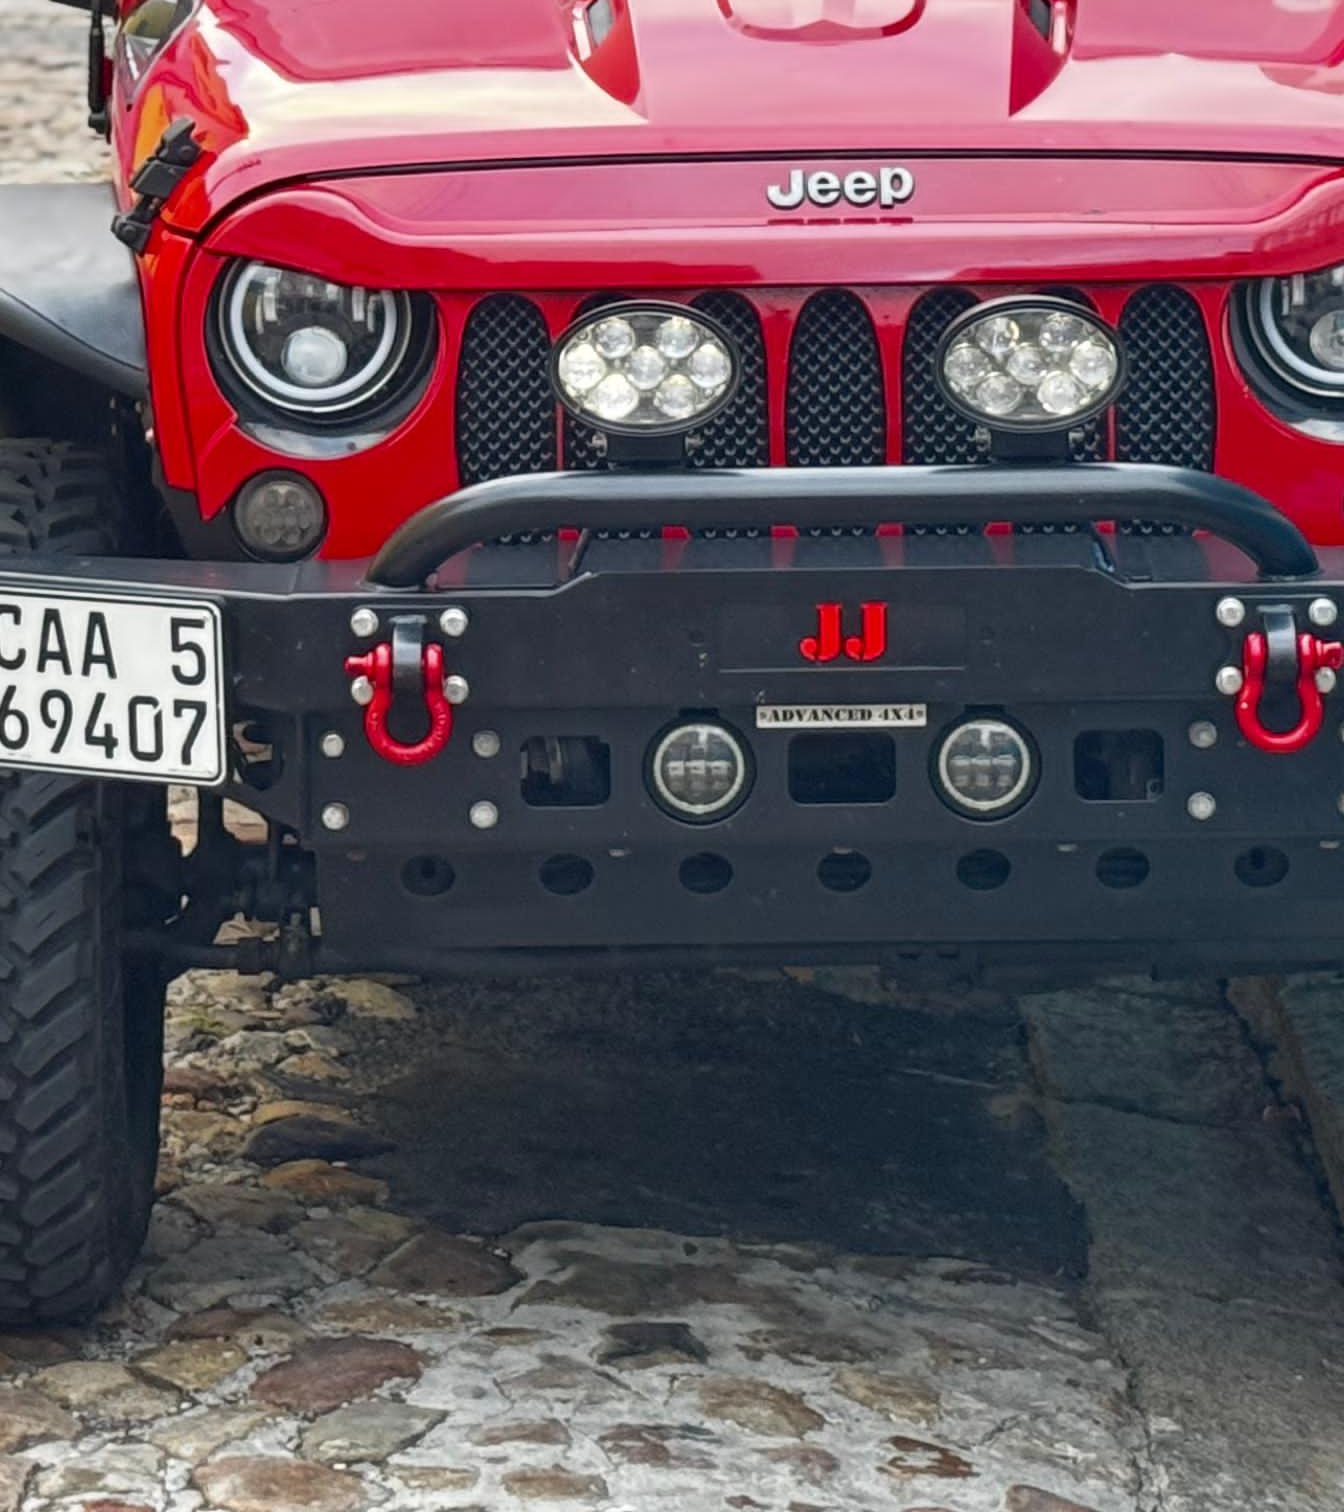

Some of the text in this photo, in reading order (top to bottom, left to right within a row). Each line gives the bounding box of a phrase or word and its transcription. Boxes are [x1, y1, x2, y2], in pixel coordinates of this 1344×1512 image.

[767, 167, 914, 209] Jeep
[170, 617, 208, 686] 5
[799, 601, 889, 662] JJ
[767, 707, 873, 723] ADVANCED
